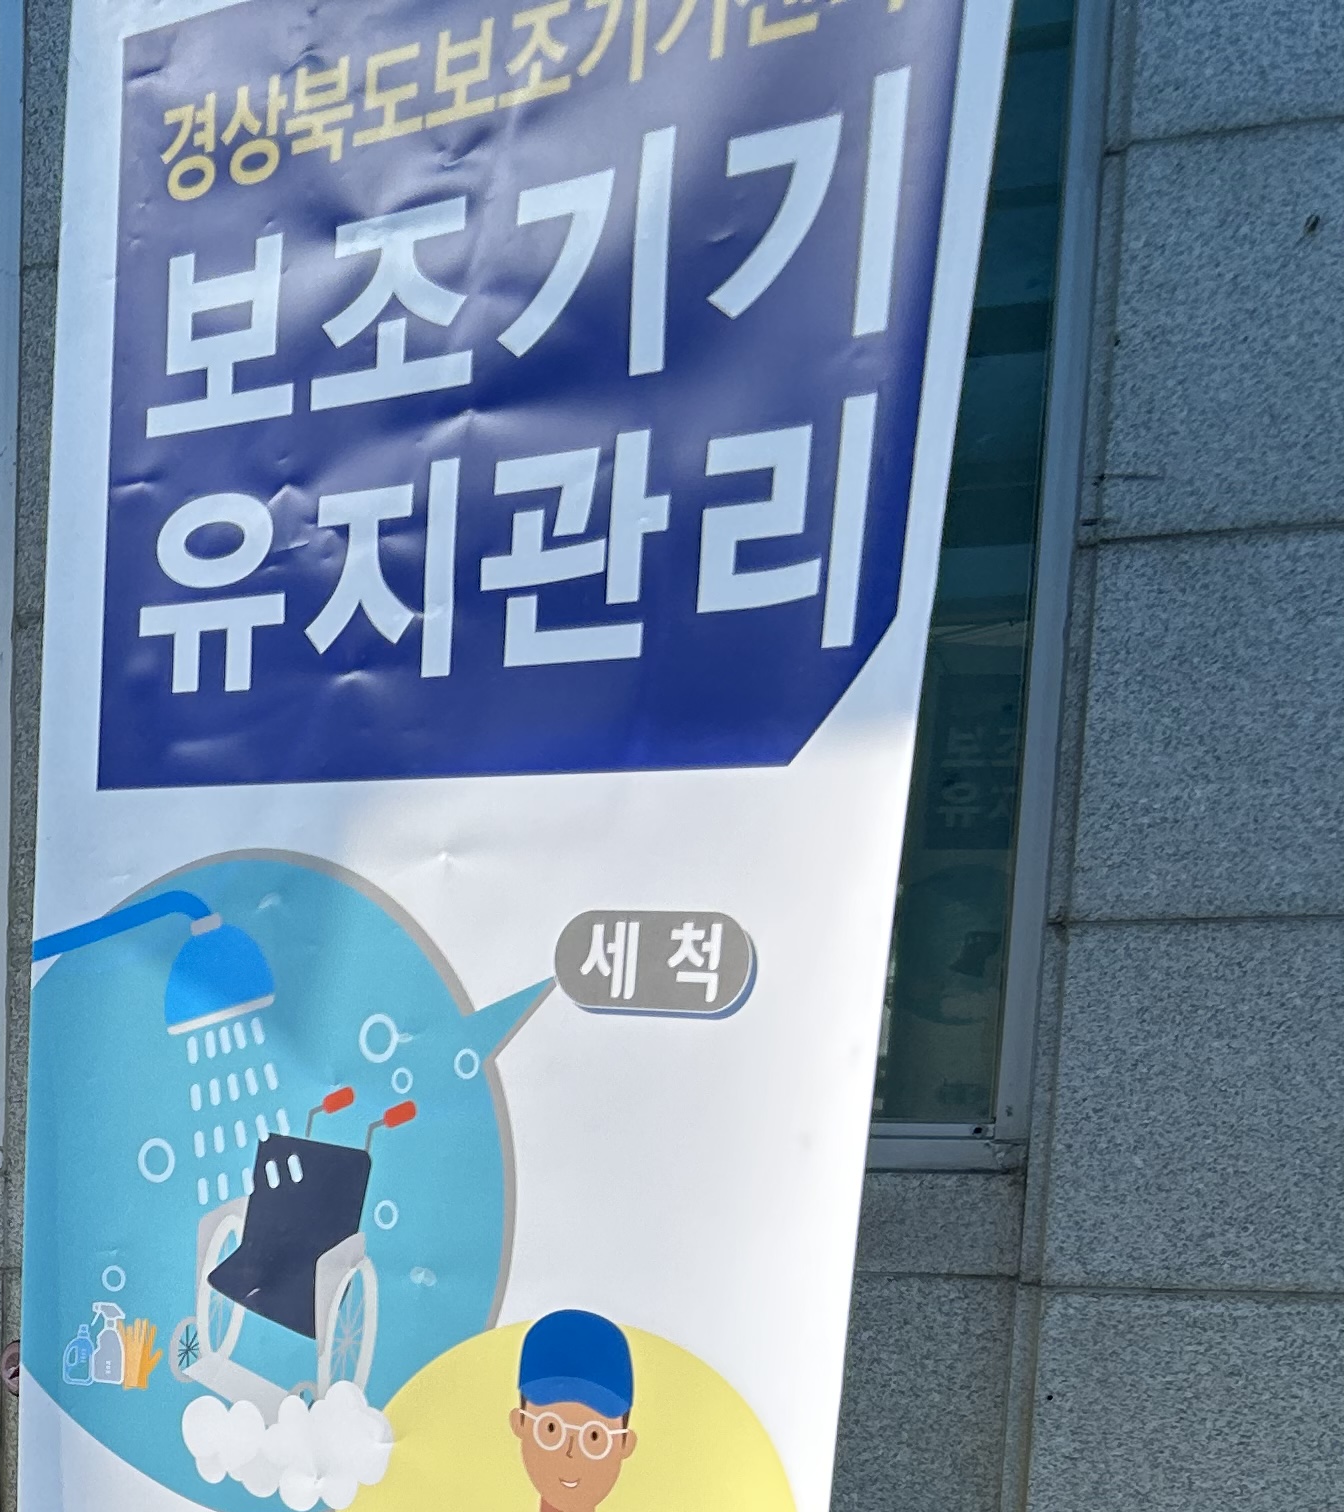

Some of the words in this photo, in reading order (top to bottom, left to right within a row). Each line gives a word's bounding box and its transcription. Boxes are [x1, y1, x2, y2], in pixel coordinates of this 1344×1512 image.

[160, 0, 904, 202] 경상북도보조기기
[145, 66, 910, 439] 보조기기
[137, 393, 878, 694] 유지관리
